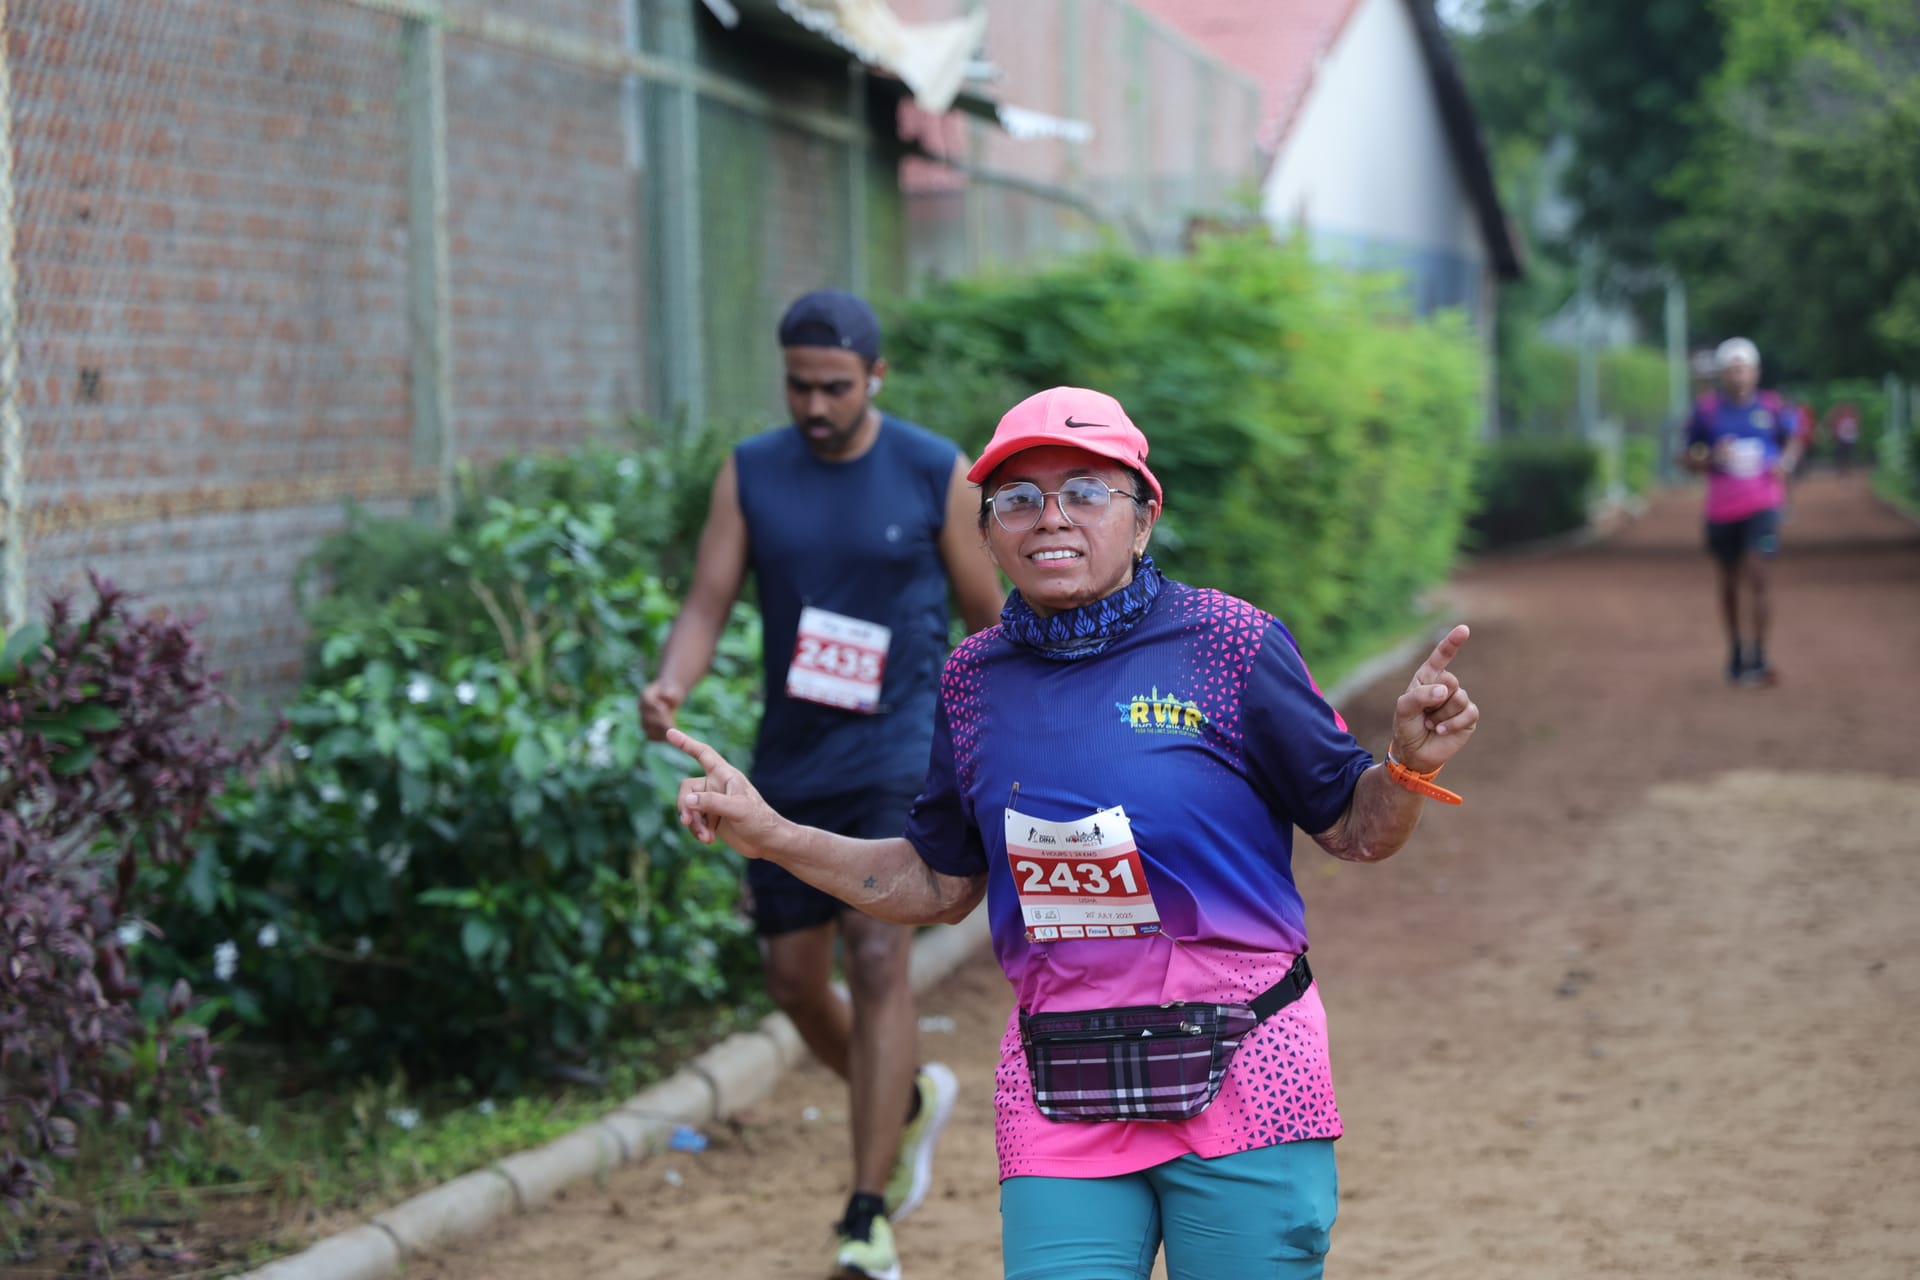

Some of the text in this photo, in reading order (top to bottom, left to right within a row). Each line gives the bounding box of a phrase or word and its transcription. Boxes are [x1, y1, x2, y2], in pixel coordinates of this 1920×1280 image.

[794, 637, 881, 681] 2435
[1130, 702, 1203, 729] RWR
[1038, 836, 1056, 845] DINA
[1016, 858, 1139, 895] 2431
